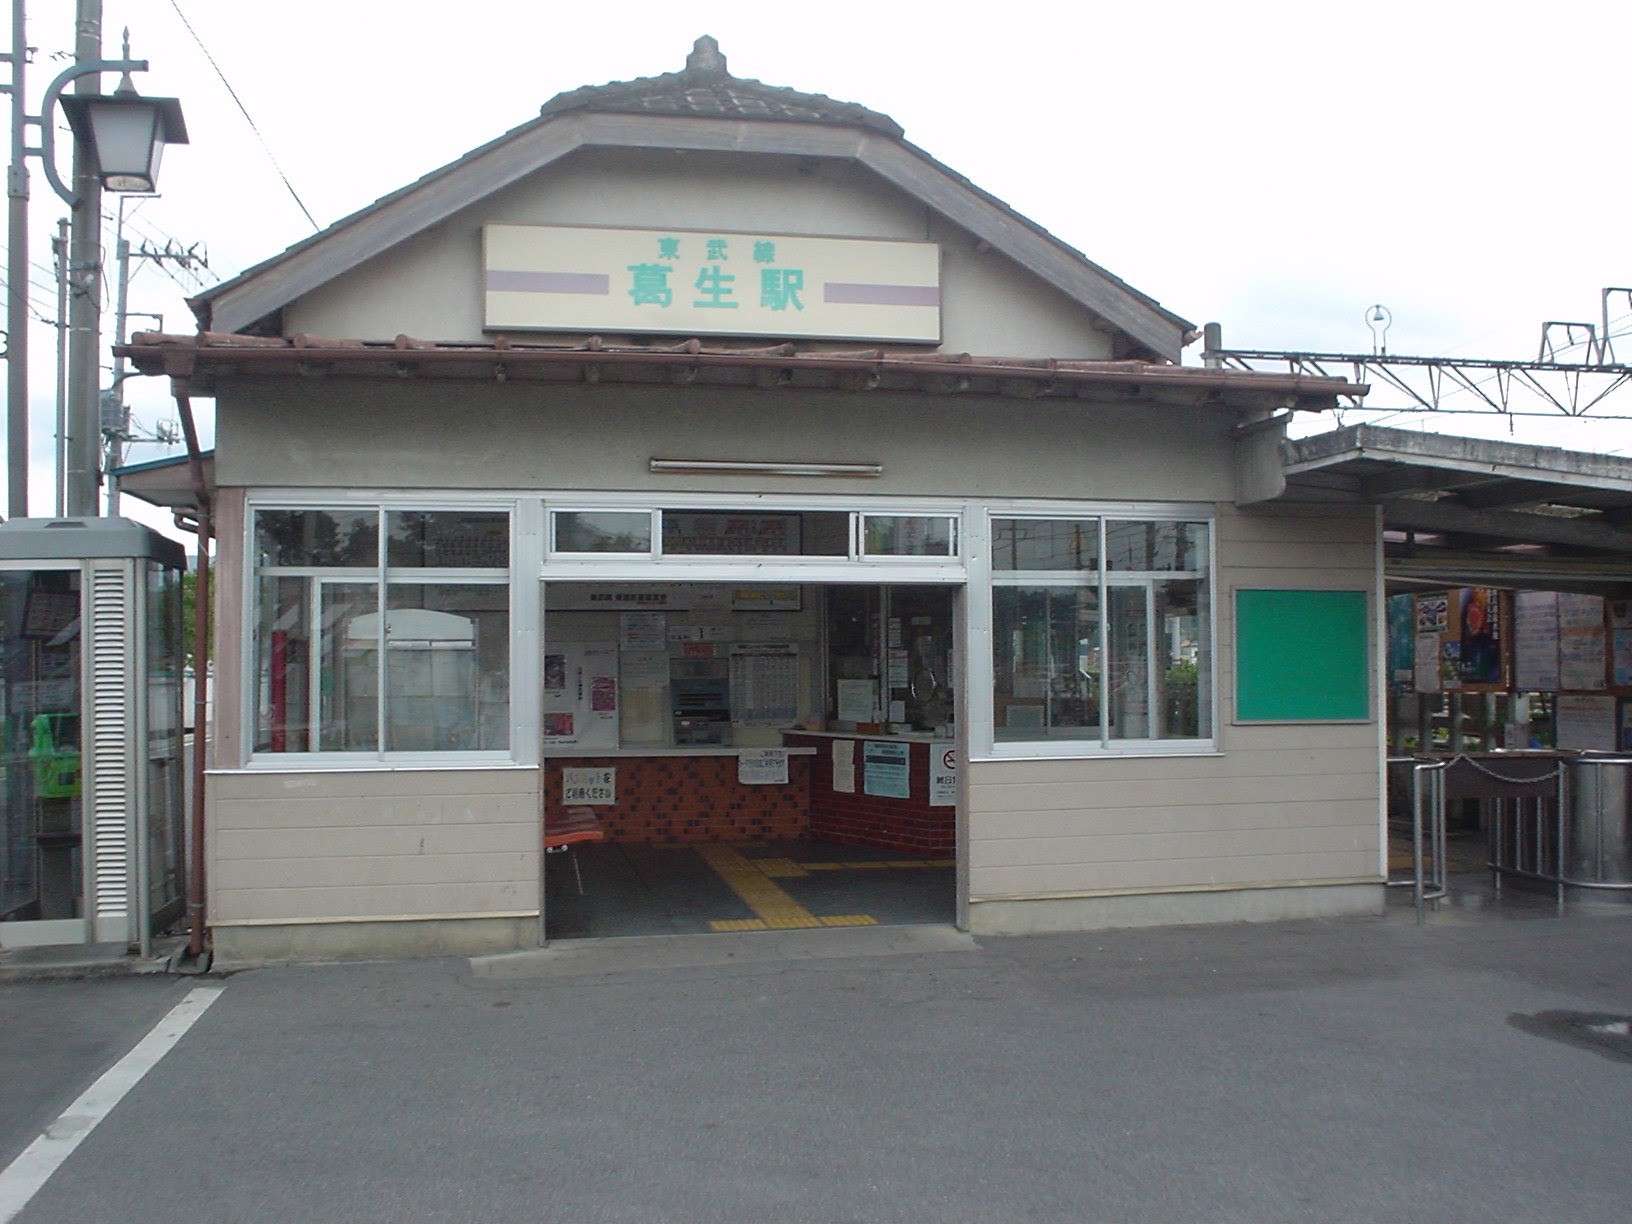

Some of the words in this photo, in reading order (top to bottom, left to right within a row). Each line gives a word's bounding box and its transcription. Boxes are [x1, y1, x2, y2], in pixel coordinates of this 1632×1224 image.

[656, 236, 776, 262] 東武線
[626, 262, 805, 311] 葛生駅
